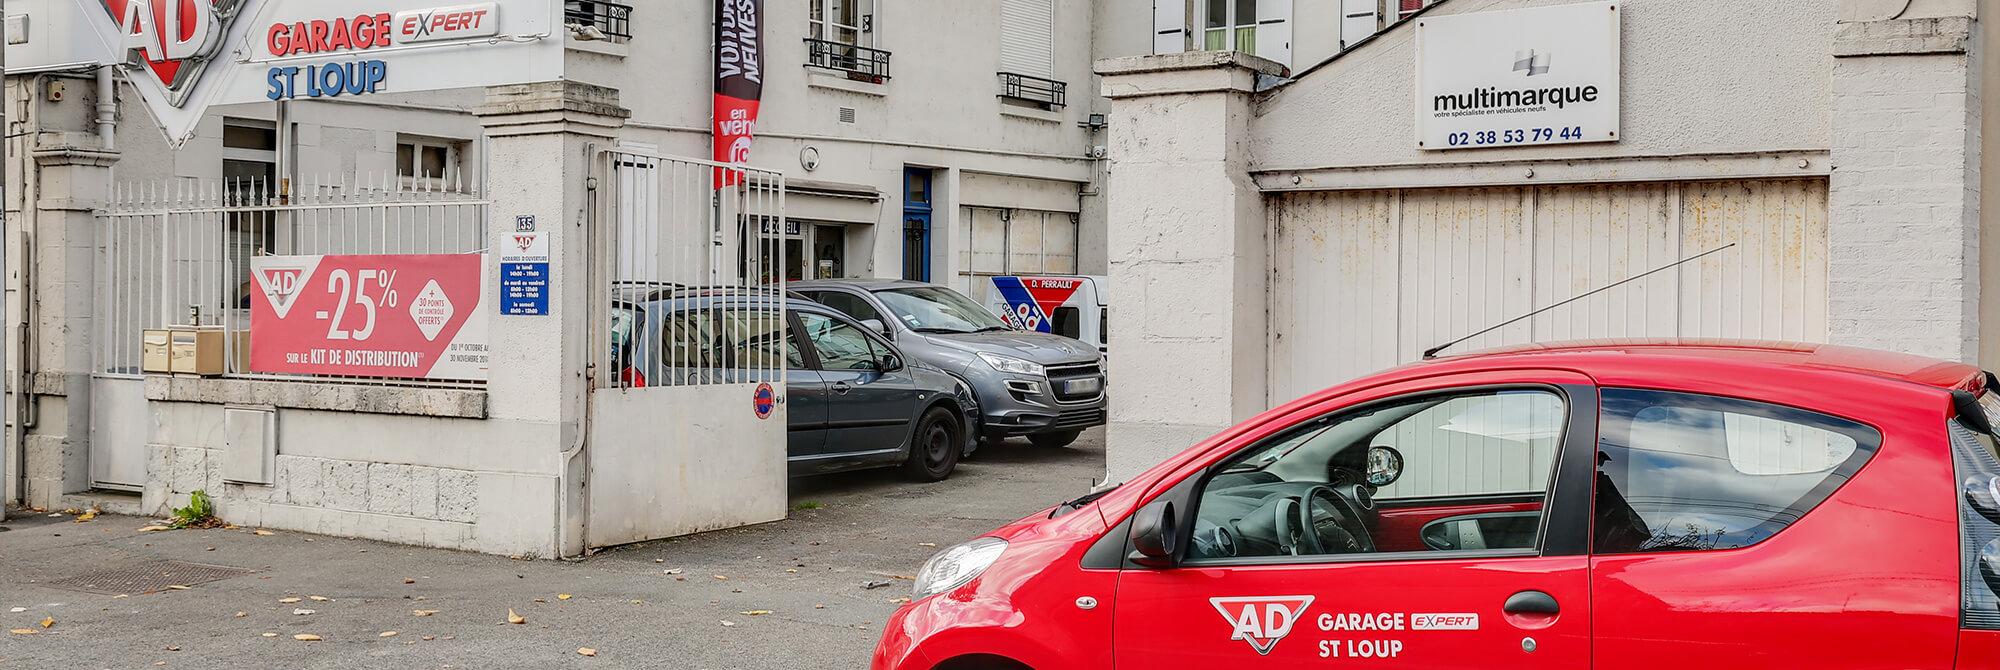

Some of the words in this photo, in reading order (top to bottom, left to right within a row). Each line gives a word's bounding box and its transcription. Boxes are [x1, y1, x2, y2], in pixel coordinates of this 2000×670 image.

[118, 0, 210, 66] AD
[267, 13, 391, 56] GARAGE
[402, 9, 487, 40] EXPERT
[266, 66, 298, 100] ST
[307, 60, 387, 97] LOUP
[1434, 85, 1598, 111] multimarque
[730, 108, 747, 120] en
[1451, 109, 1485, 118] spécialiste
[1496, 107, 1526, 115] véhicules
[719, 119, 757, 136] ven
[1448, 132, 1469, 146] 02
[1475, 130, 1497, 144] 38
[1503, 129, 1524, 143] 53
[1532, 127, 1553, 142] 79
[1559, 126, 1582, 140] 44
[518, 219, 532, 230] 135
[517, 237, 532, 248] AD
[268, 271, 297, 297] AD
[1041, 280, 1073, 289] PERRAULT
[419, 297, 427, 307] 30
[427, 299, 445, 307] POINTS
[286, 352, 299, 364] SUR
[300, 353, 308, 364] LE
[310, 348, 326, 364] KIT
[329, 349, 342, 365] DE
[345, 349, 418, 368] DISTRIBUTION
[1231, 603, 1293, 641] AD
[1317, 612, 1405, 631] GARAGE
[1415, 614, 1474, 628] EXPERT
[1319, 640, 1341, 658] ST
[1349, 640, 1403, 658] LOUP
